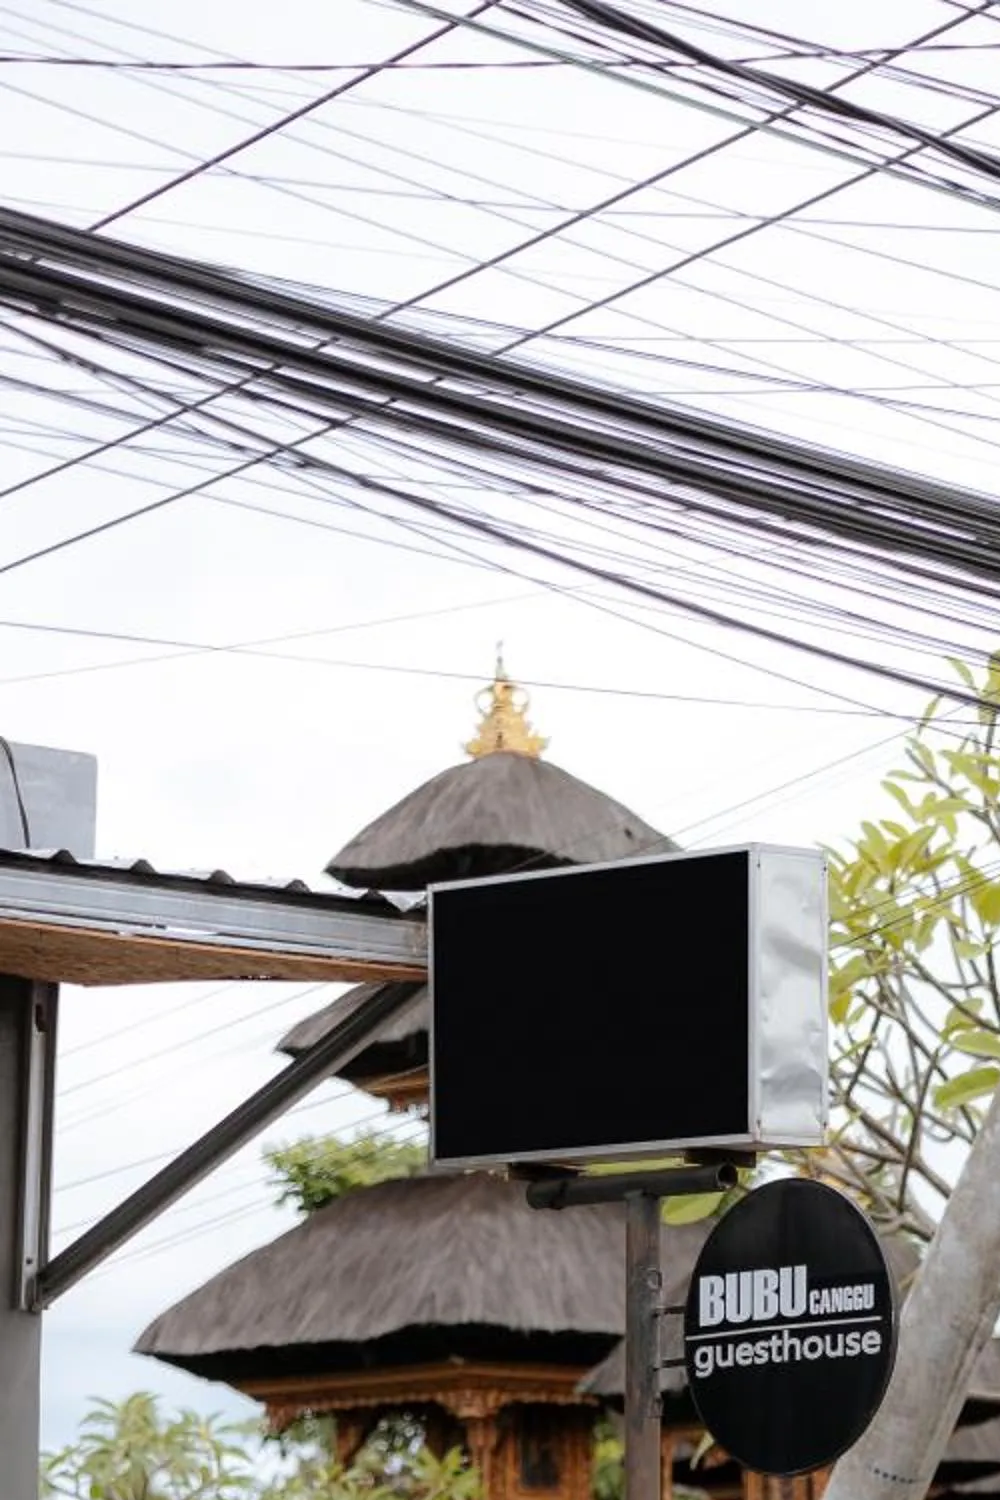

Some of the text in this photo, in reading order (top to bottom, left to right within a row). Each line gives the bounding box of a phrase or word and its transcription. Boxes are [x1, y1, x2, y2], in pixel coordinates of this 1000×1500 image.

[699, 1264, 875, 1328] BUBU CANGGU
[694, 1329, 883, 1379] guesthouse
